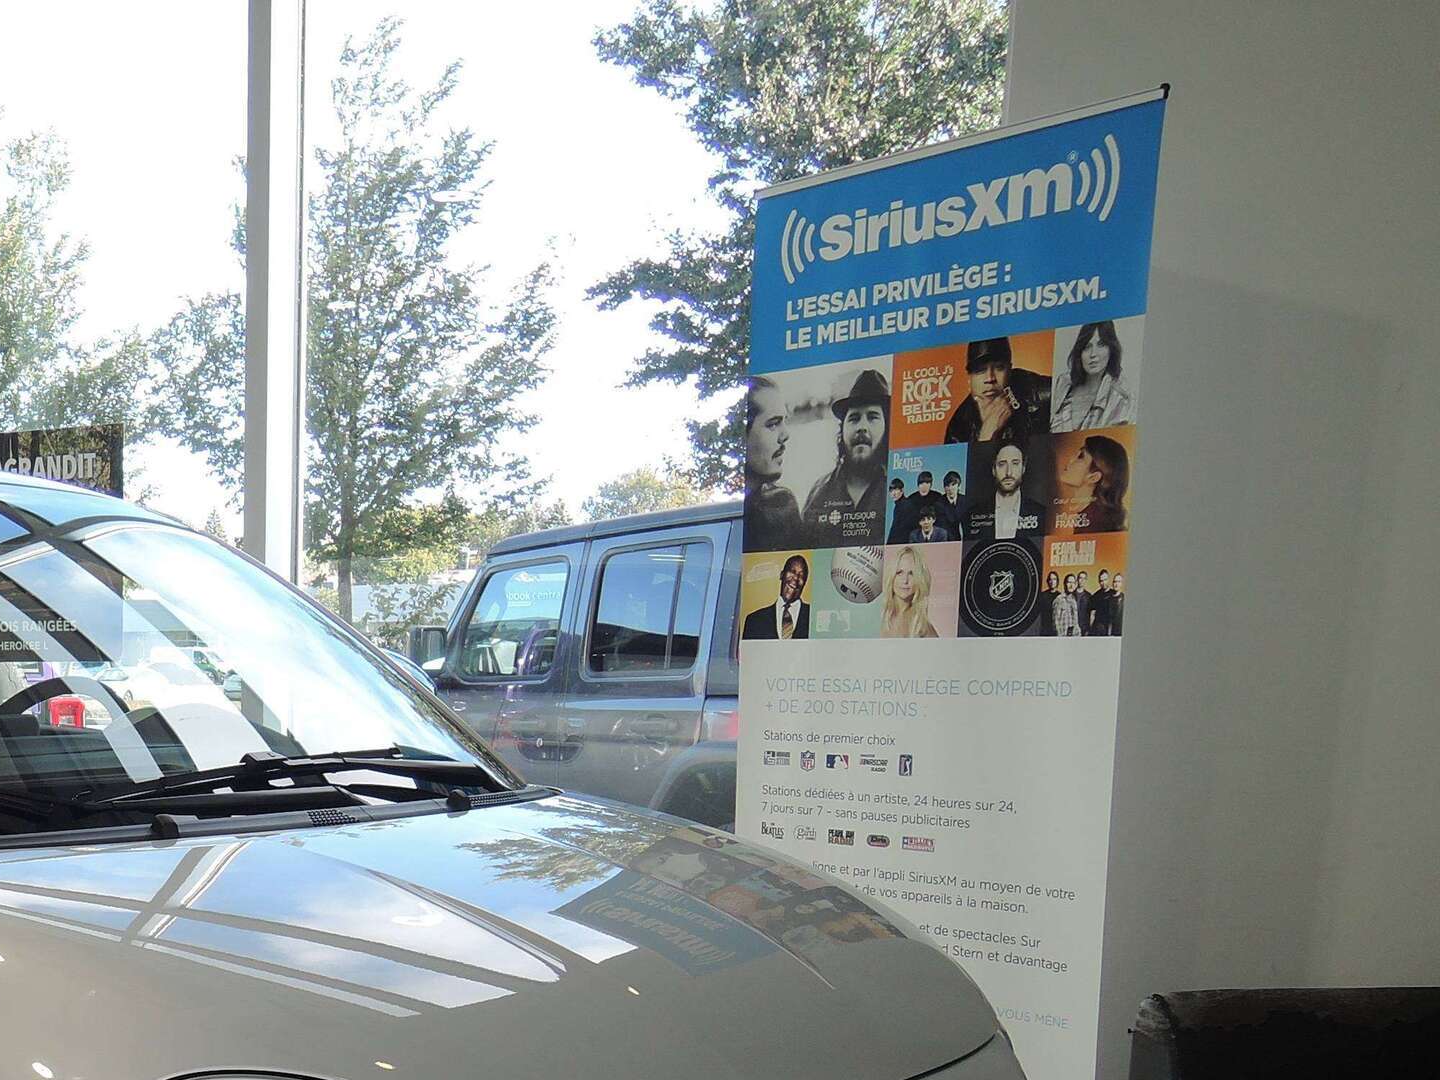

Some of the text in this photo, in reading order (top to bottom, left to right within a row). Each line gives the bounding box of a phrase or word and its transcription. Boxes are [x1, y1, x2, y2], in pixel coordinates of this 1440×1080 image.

[785, 285, 867, 321] L'ESSAI
[872, 262, 998, 304] PRIVILÈGE
[784, 276, 1107, 351] LE MEILLEUR DE SIRIUSXM.
[914, 366, 941, 379] COOL
[902, 375, 952, 403] ROCK
[902, 399, 952, 416] BELLS
[906, 412, 945, 425] RADIO
[22, 617, 78, 633] RANGÉES
[766, 678, 816, 692] VOTRE
[822, 678, 867, 693] ESSAI
[967, 679, 1072, 697] COMPREND
[779, 700, 800, 713] DE
[804, 700, 834, 715] 200
[840, 701, 918, 717] STATIONS
[764, 730, 896, 746] Stations de premier choix
[762, 784, 1017, 814] Stations dédiées à un artiste, 24 heures sur 24,
[762, 802, 768, 811] 7
[769, 802, 794, 815] jours
[797, 807, 813, 816] sur
[816, 806, 823, 816] 7
[835, 810, 857, 820] sans
[861, 811, 897, 824] pauses
[901, 813, 970, 829] publicitaires
[839, 865, 849, 875] et
[853, 867, 870, 878] par
[874, 867, 905, 882] l'appli
[909, 871, 957, 887] SiriusXM
[961, 879, 975, 889] au
[979, 880, 1022, 895] moyen
[1026, 884, 1041, 896] de
[1045, 888, 1076, 901] votre
[862, 884, 1029, 914] de vos appareils à la maison.
[934, 924, 948, 937] de
[952, 928, 1016, 945] spectacles
[1021, 935, 1041, 949] Sur
[952, 944, 983, 960] Stern
[987, 951, 1000, 962] et
[1004, 951, 1068, 972] davantage
[998, 1007, 1031, 1022] VOUS
